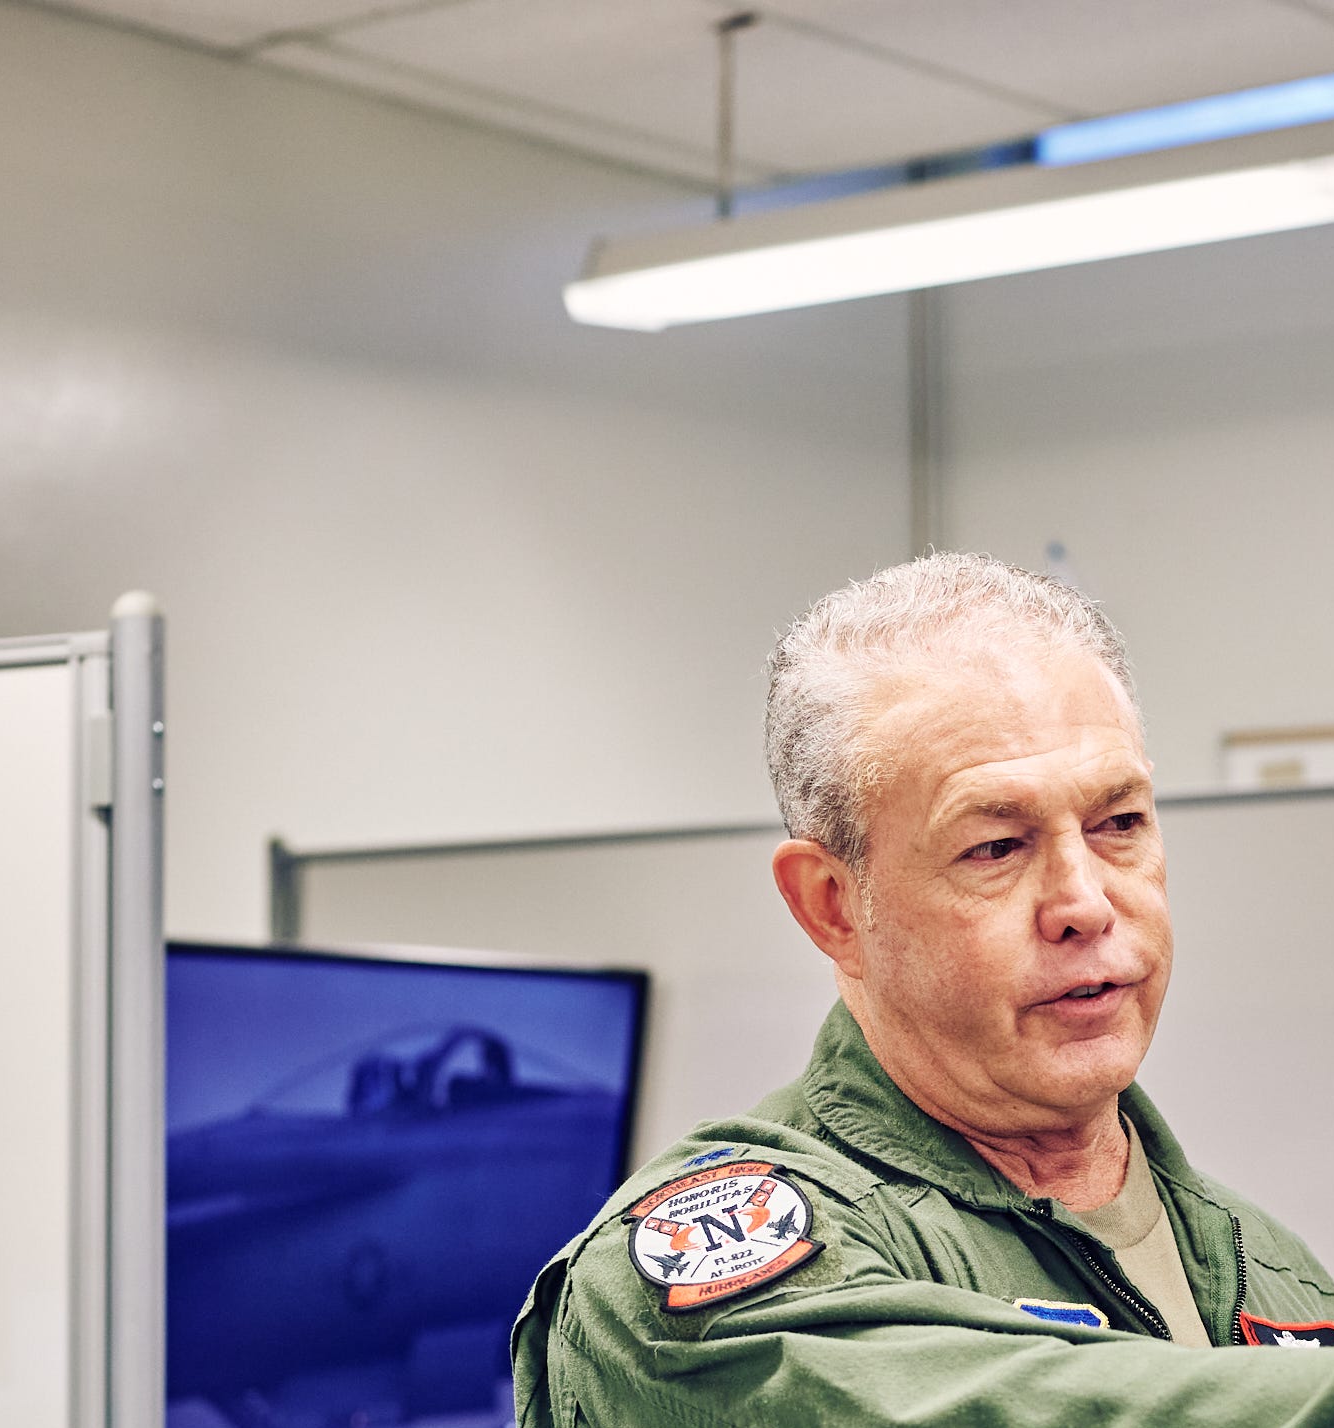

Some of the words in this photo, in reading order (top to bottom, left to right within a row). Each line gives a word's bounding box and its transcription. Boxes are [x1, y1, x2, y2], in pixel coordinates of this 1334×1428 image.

[642, 1171, 718, 1209] NORTHEAST
[728, 1165, 762, 1175] HIGH
[668, 1179, 739, 1208] HONORIS
[692, 1204, 746, 1252] N
[714, 1249, 754, 1265] FL-822
[699, 1260, 787, 1297] HURRICANES
